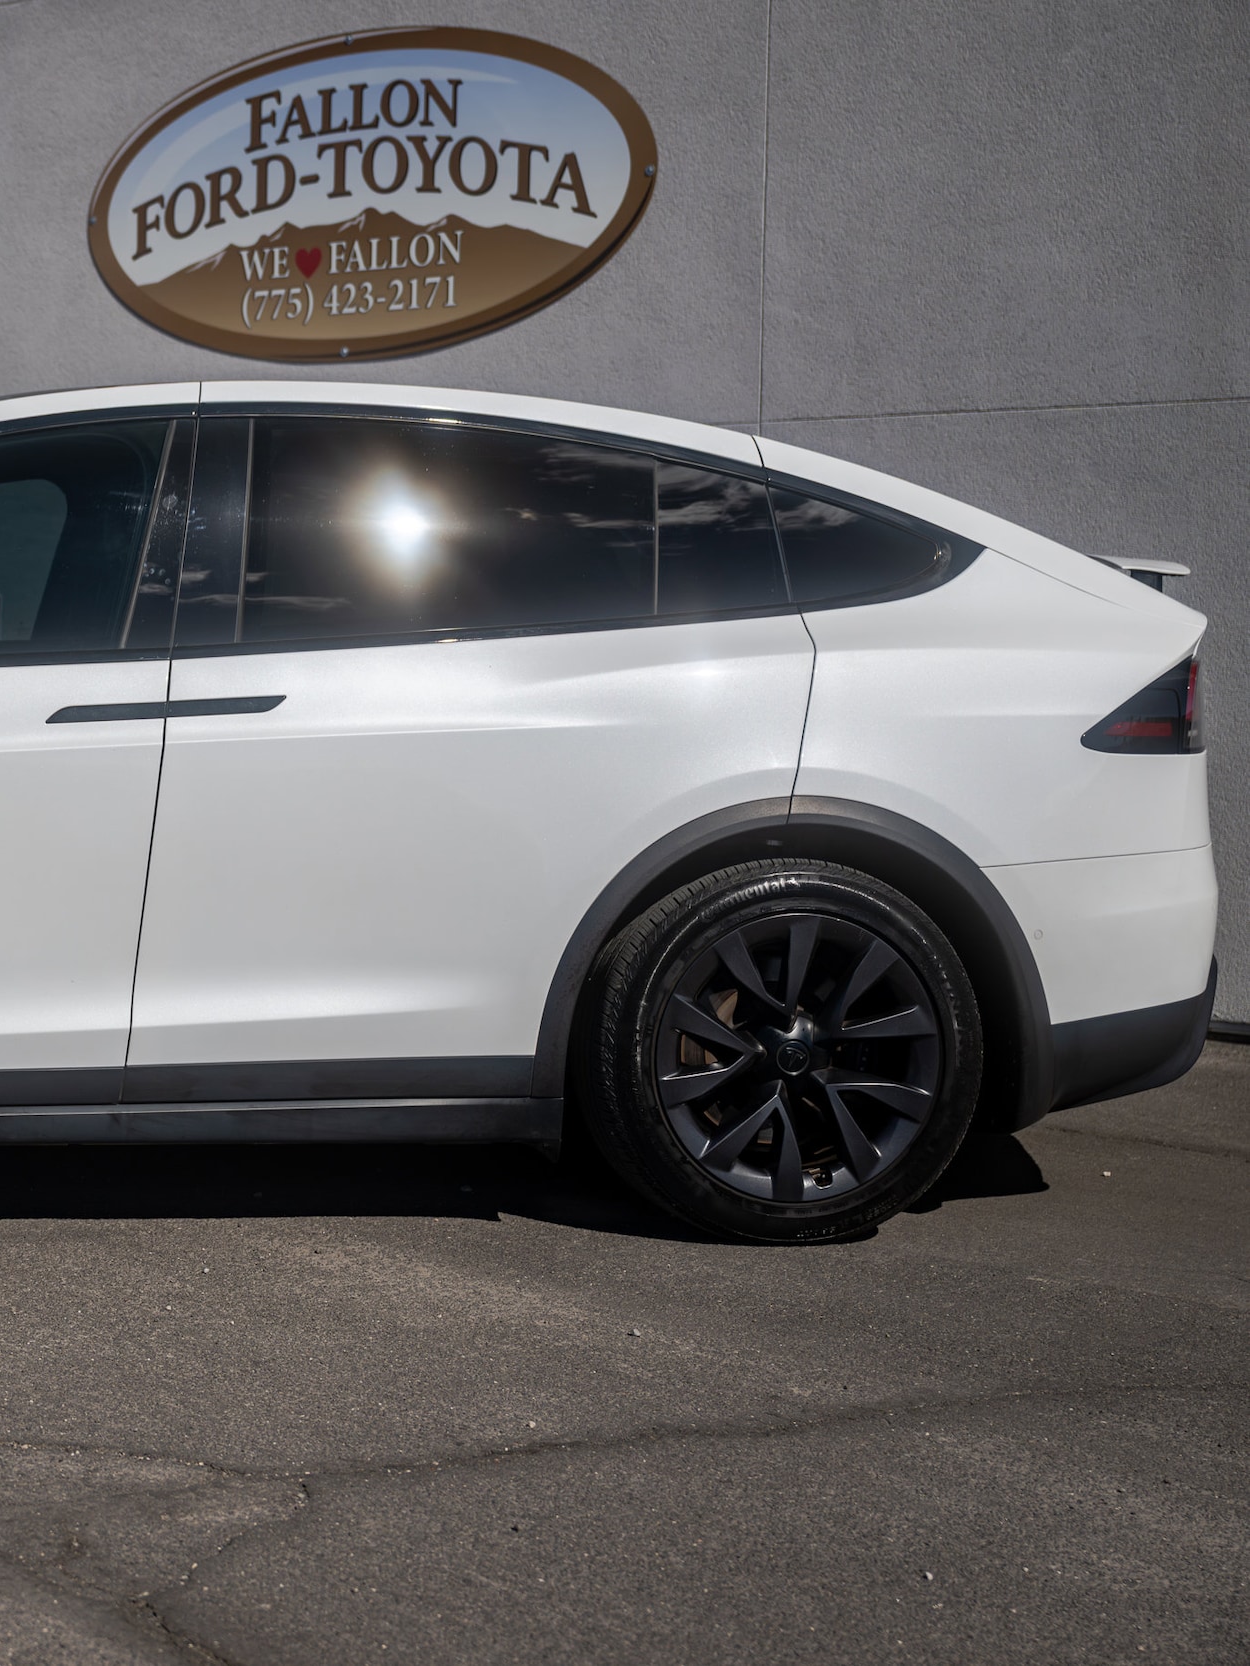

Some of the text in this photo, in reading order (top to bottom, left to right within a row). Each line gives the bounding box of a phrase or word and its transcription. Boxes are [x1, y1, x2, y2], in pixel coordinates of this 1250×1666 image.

[244, 78, 464, 154] FALLON
[131, 135, 599, 261] FORD-TOYOTA
[240, 230, 466, 283] WE FALLON
[240, 275, 459, 329] (775) 423-2171
